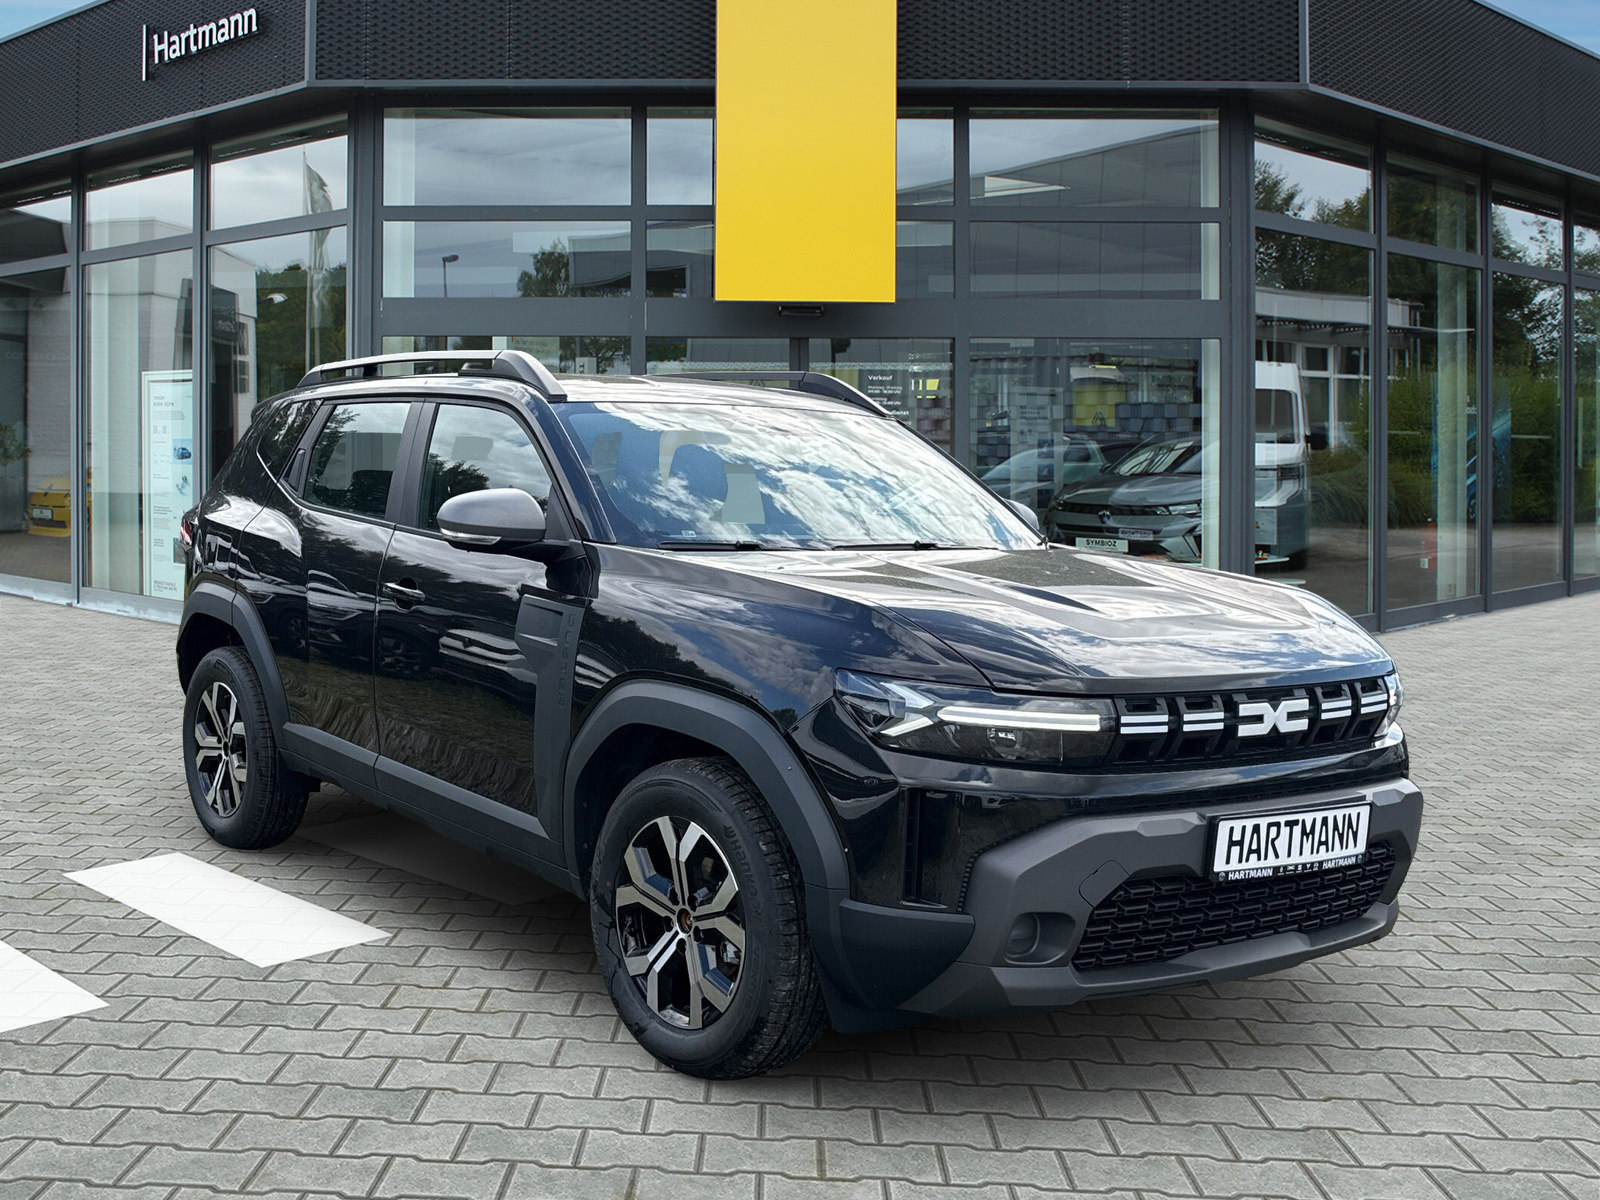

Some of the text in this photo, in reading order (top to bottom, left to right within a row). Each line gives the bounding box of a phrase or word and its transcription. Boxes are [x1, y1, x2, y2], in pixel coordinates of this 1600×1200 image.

[153, 8, 258, 64] Hartmann
[1086, 539, 1117, 547] SYMBIOZ
[1225, 812, 1361, 865] HARTMANN
[1228, 868, 1273, 880] HARTMANN
[1322, 856, 1356, 869] HARTMANN
